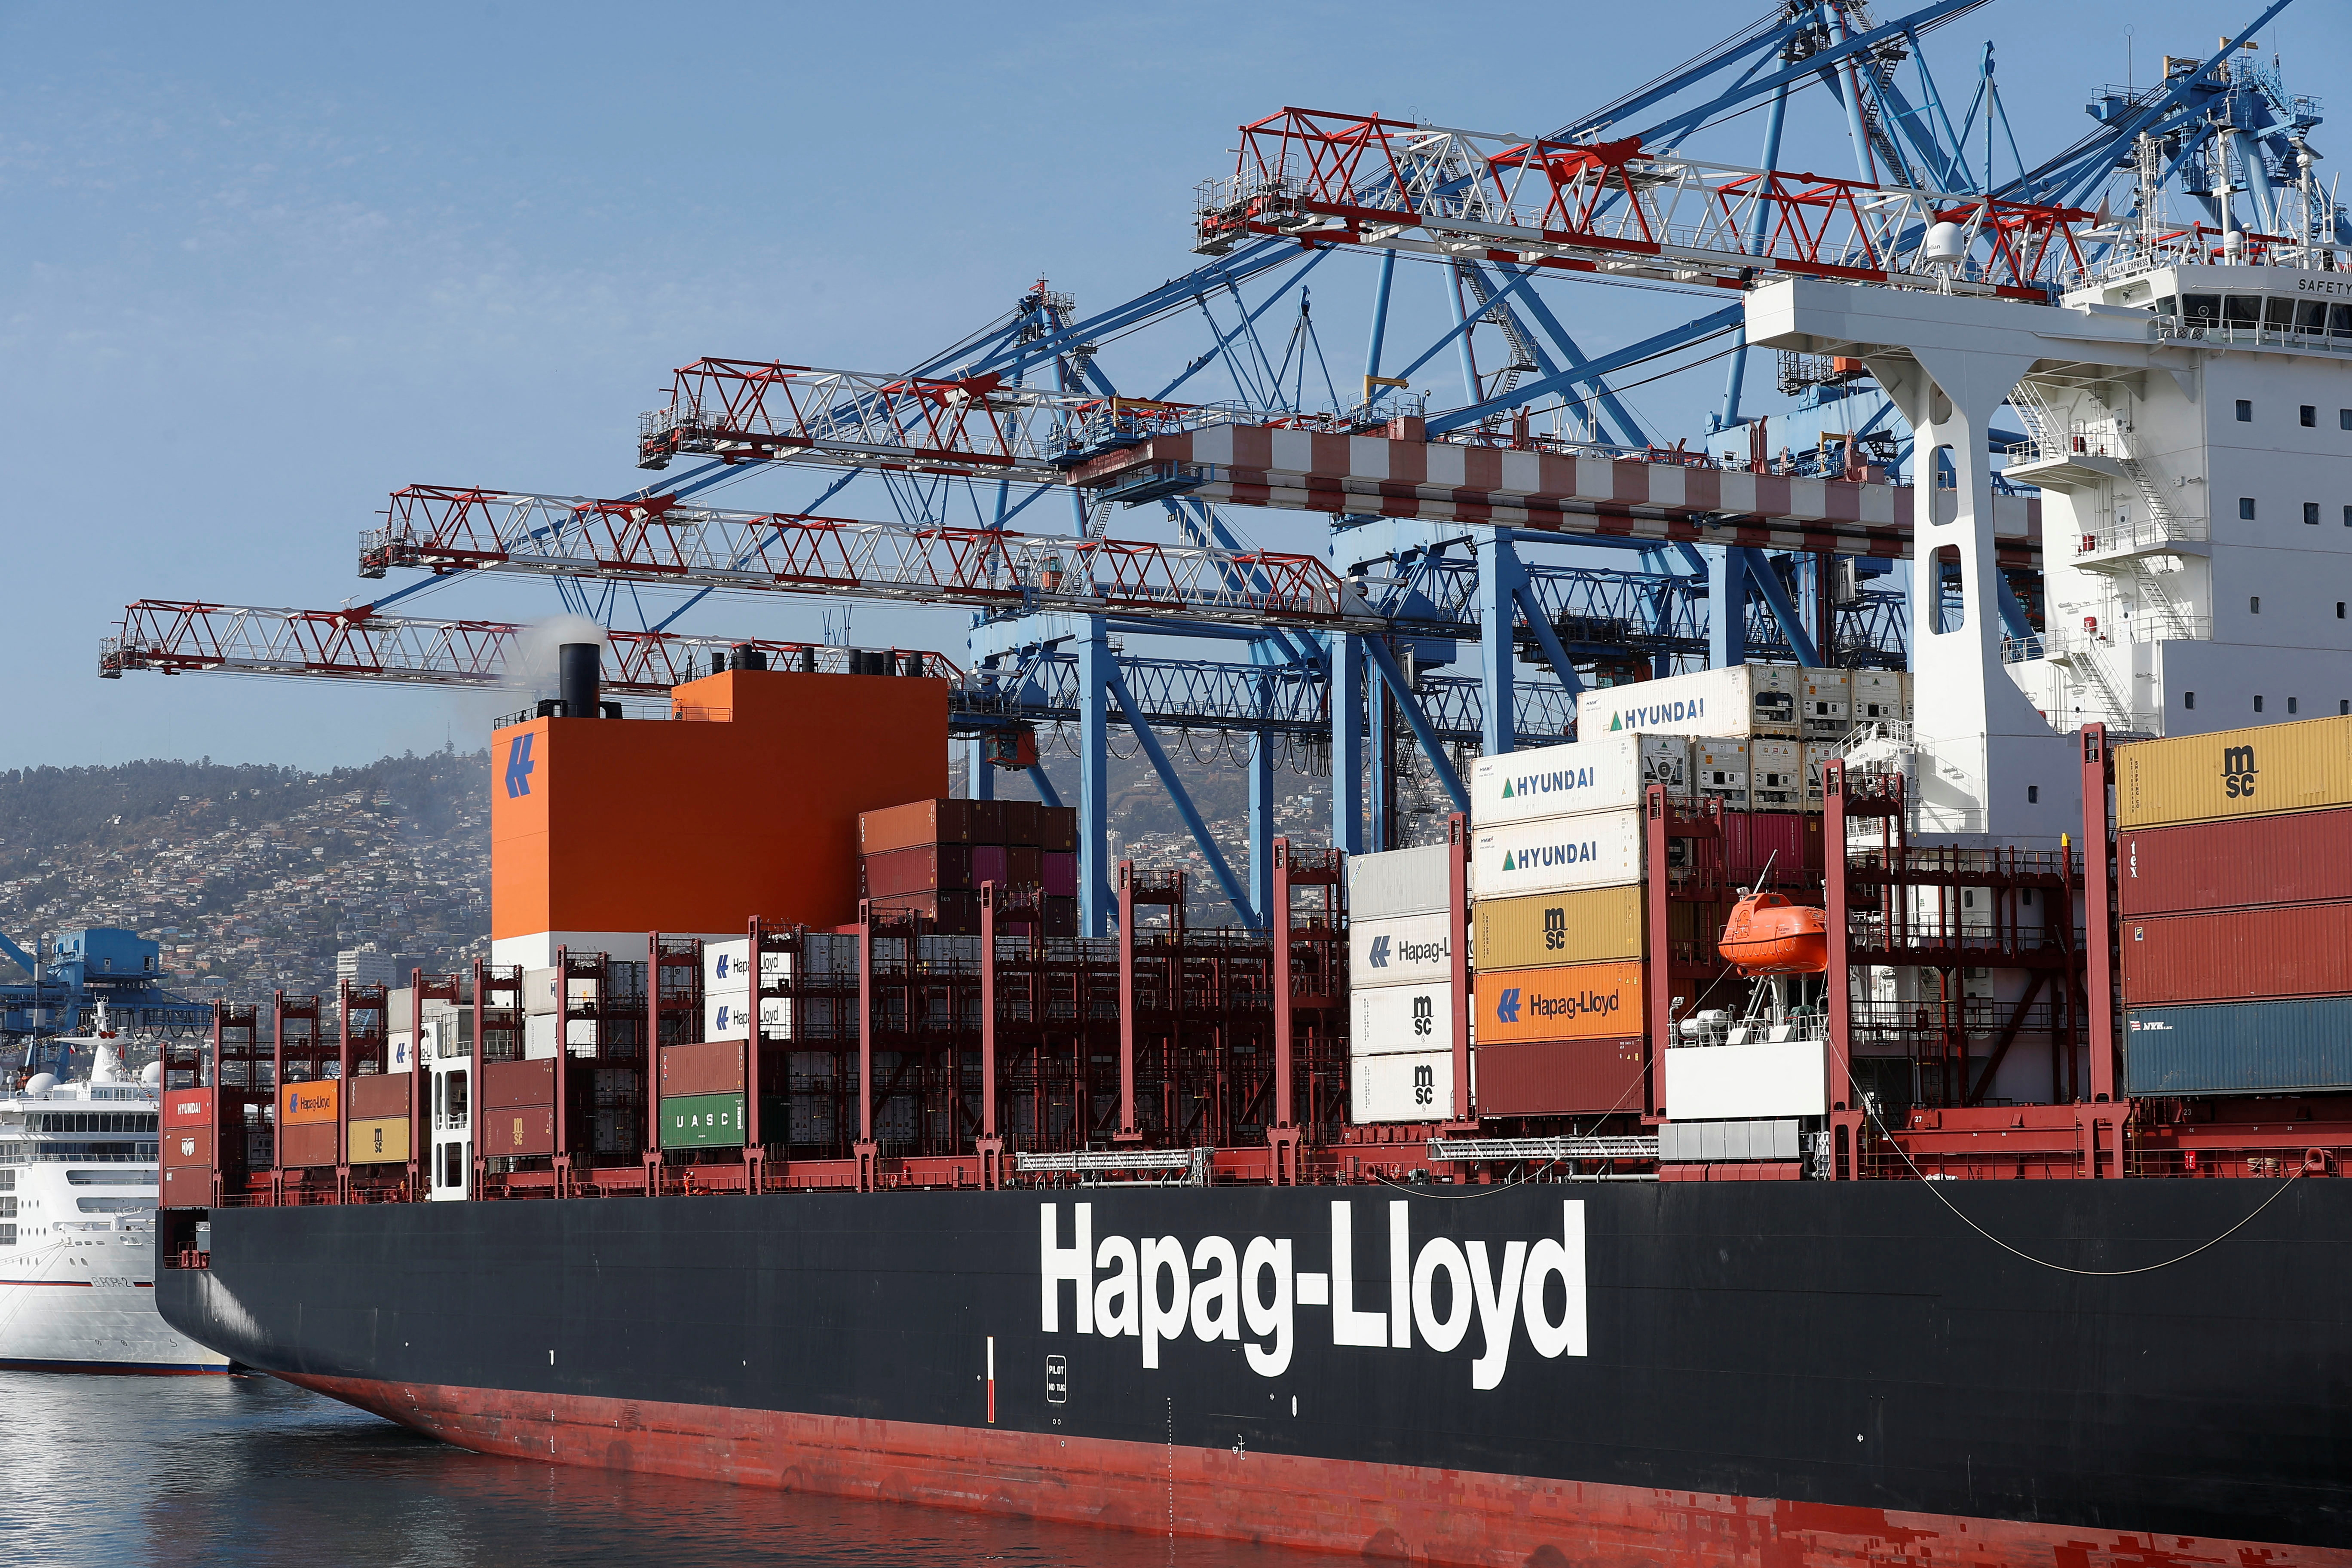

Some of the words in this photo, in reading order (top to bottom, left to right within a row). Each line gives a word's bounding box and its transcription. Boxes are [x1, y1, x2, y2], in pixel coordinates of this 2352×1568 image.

[2110, 265, 2125, 275] ITAJAI
[2128, 258, 2148, 270] EXPRESS
[2299, 279, 2352, 295] SAFETY
[1626, 698, 1703, 729] HYUNDAI
[1517, 767, 1593, 796] HYUNDAI
[1519, 841, 1596, 869] HYUNDAI
[2130, 840, 2138, 878] tex
[1530, 989, 1619, 1020] Hapag-Lloyd
[2143, 1022, 2164, 1030] NYK
[177, 1102, 201, 1115] HYUNDAI
[300, 1095, 330, 1112] Hapag-Lloyd
[677, 1113, 728, 1127] UASC
[91, 1277, 125, 1287] EUROPA
[121, 1277, 132, 1287] 2
[1039, 1199, 1588, 1390] Hapag-Lloyd
[1049, 1365, 1064, 1375] PILOT
